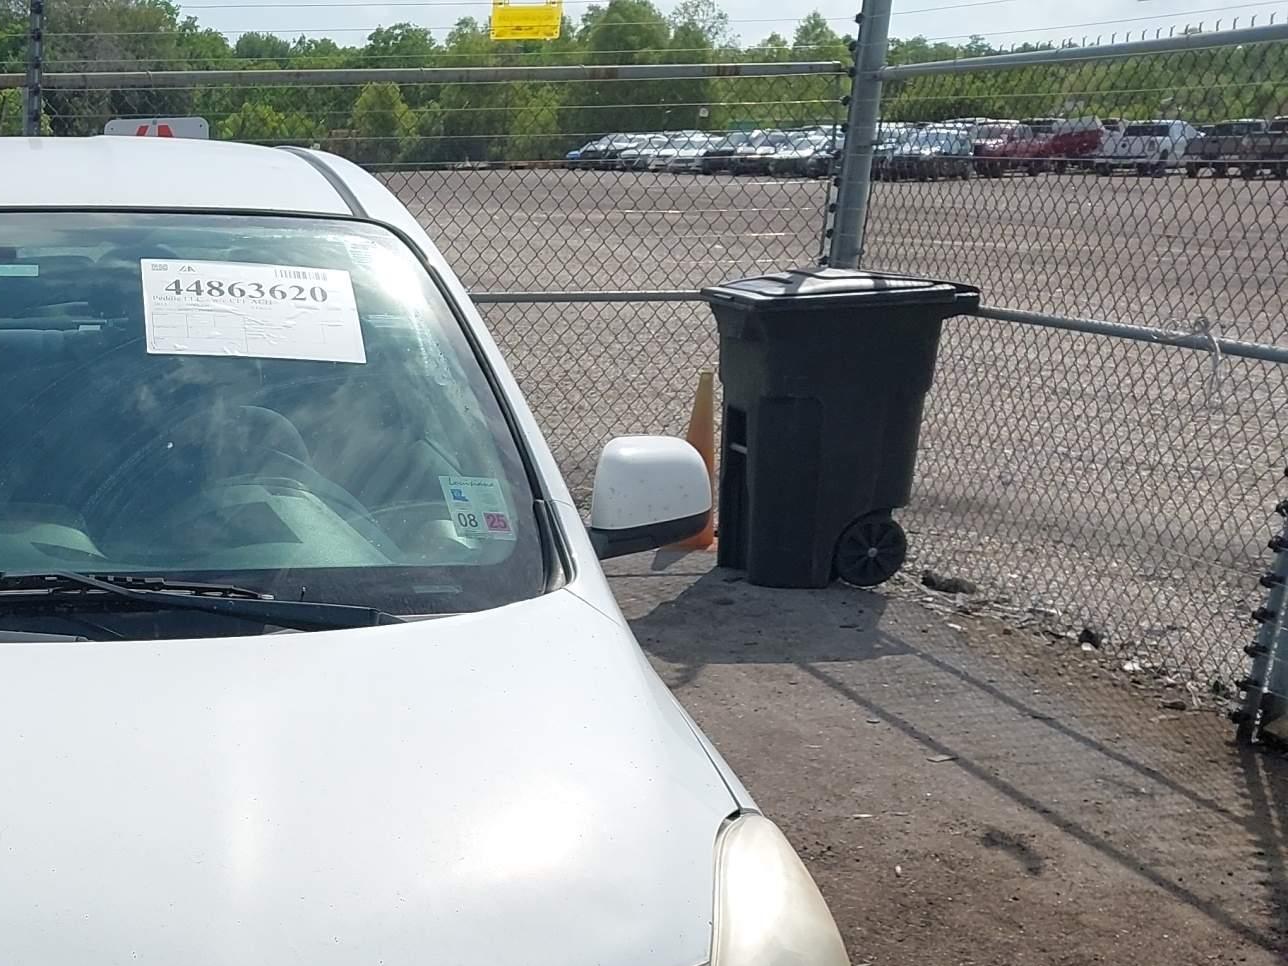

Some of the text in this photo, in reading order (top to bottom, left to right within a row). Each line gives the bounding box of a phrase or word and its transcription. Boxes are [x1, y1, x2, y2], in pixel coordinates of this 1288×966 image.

[165, 279, 328, 303] 44863620
[457, 512, 507, 529] 08 25
